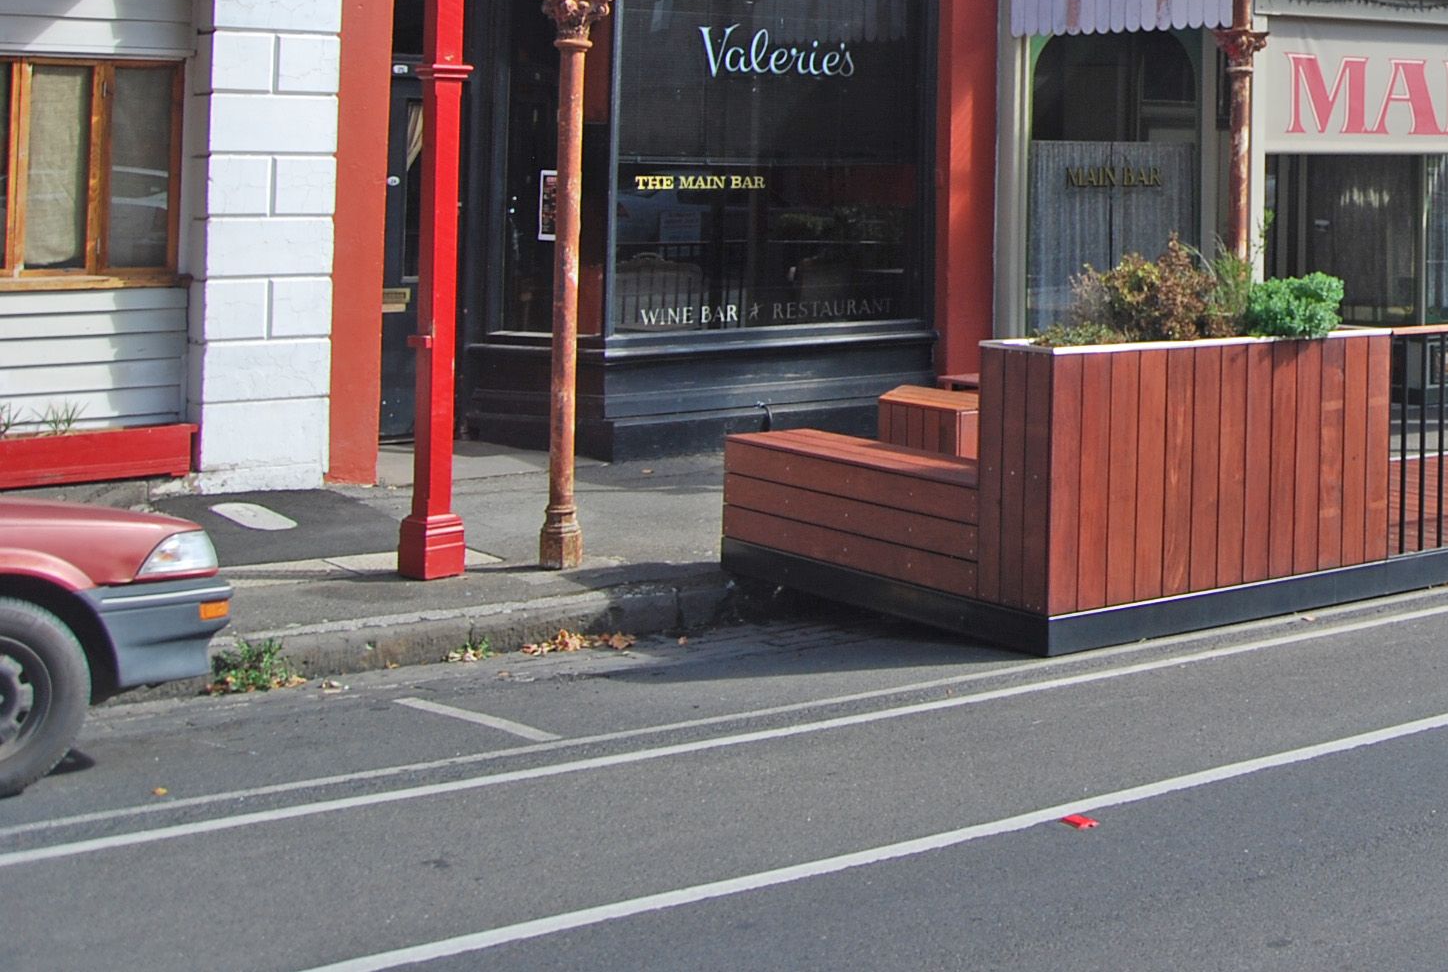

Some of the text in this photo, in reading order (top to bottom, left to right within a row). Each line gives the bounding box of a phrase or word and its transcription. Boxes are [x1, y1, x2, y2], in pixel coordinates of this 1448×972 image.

[698, 22, 855, 78] Valerie's
[635, 175, 766, 189] THE MAIN BAR
[1065, 167, 1161, 188] MAIN BAR
[641, 298, 893, 326] WINE BAR RESTAURANT
